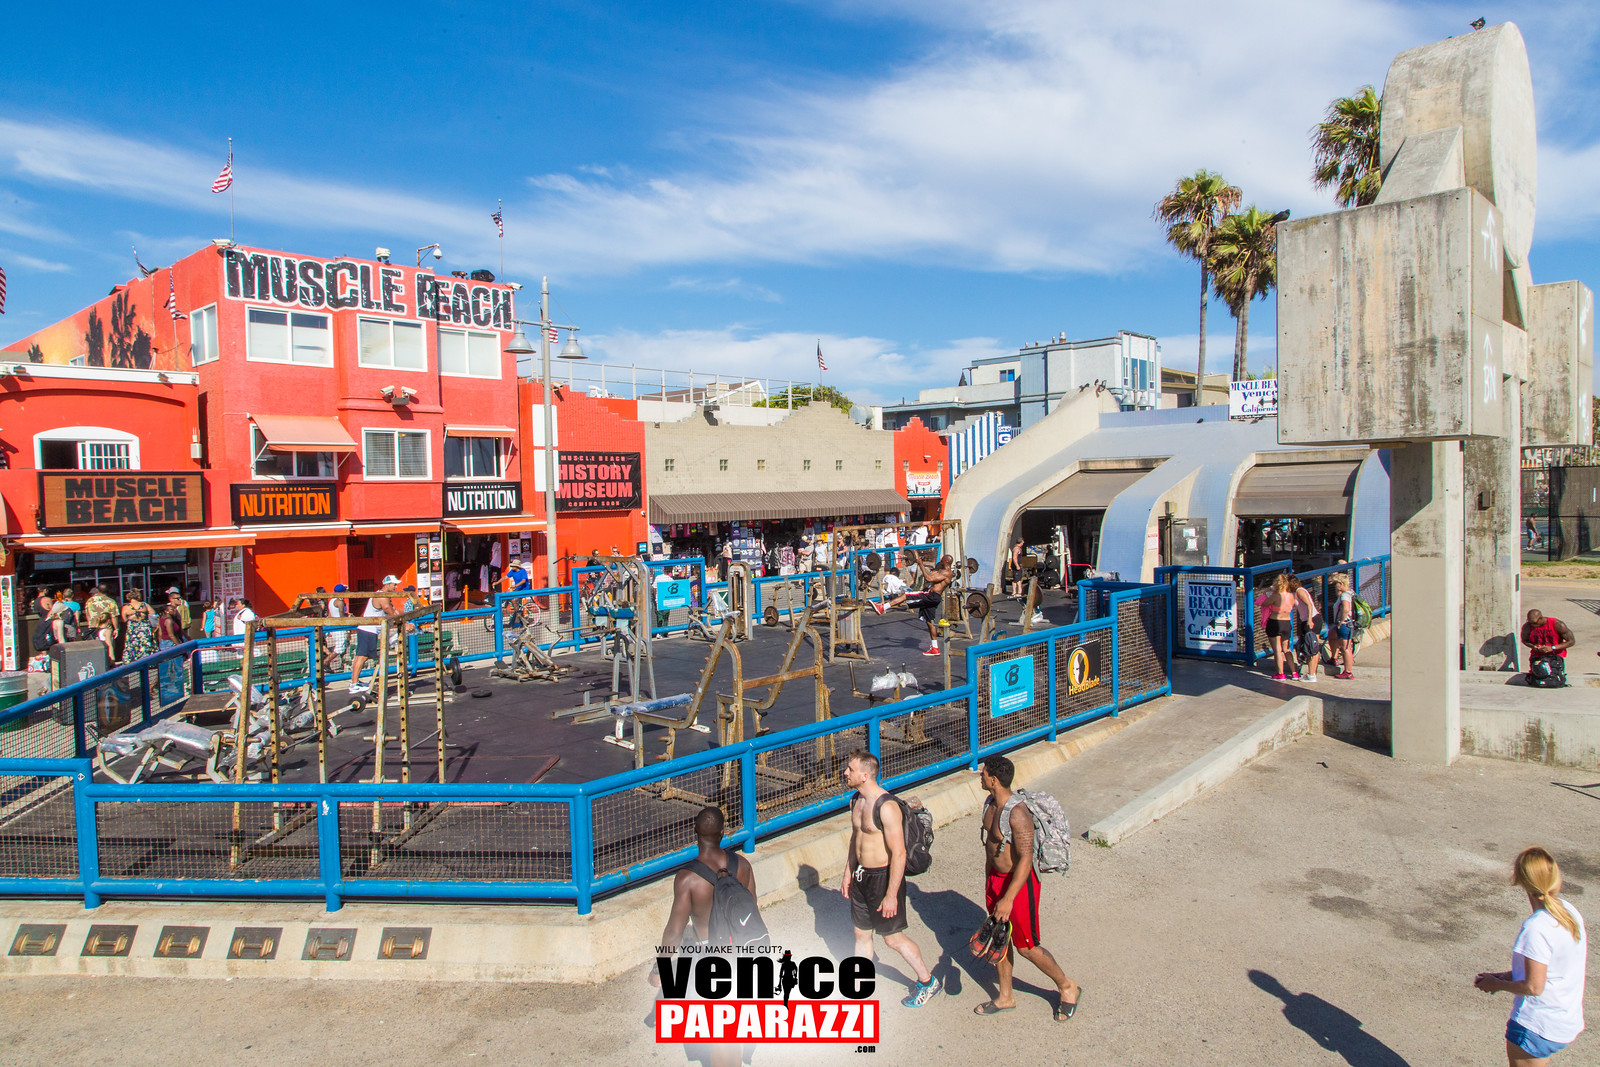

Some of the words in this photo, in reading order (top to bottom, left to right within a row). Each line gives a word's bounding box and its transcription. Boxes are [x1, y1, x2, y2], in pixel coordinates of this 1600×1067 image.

[225, 249, 405, 315] MUSCLE
[416, 272, 513, 331] BEACH
[1231, 381, 1260, 391] MUSCLE
[558, 464, 632, 480] HISTORY
[65, 478, 187, 498] MUSCLE
[555, 481, 633, 499] MUSEUM
[239, 492, 331, 517] NUTRITION
[447, 489, 517, 512] NUTRITION
[65, 497, 188, 524] BEACH
[1188, 585, 1232, 598] MUSCLE
[1188, 596, 1232, 611] BEACH
[1188, 609, 1232, 621] Venice
[1187, 623, 1234, 639] California
